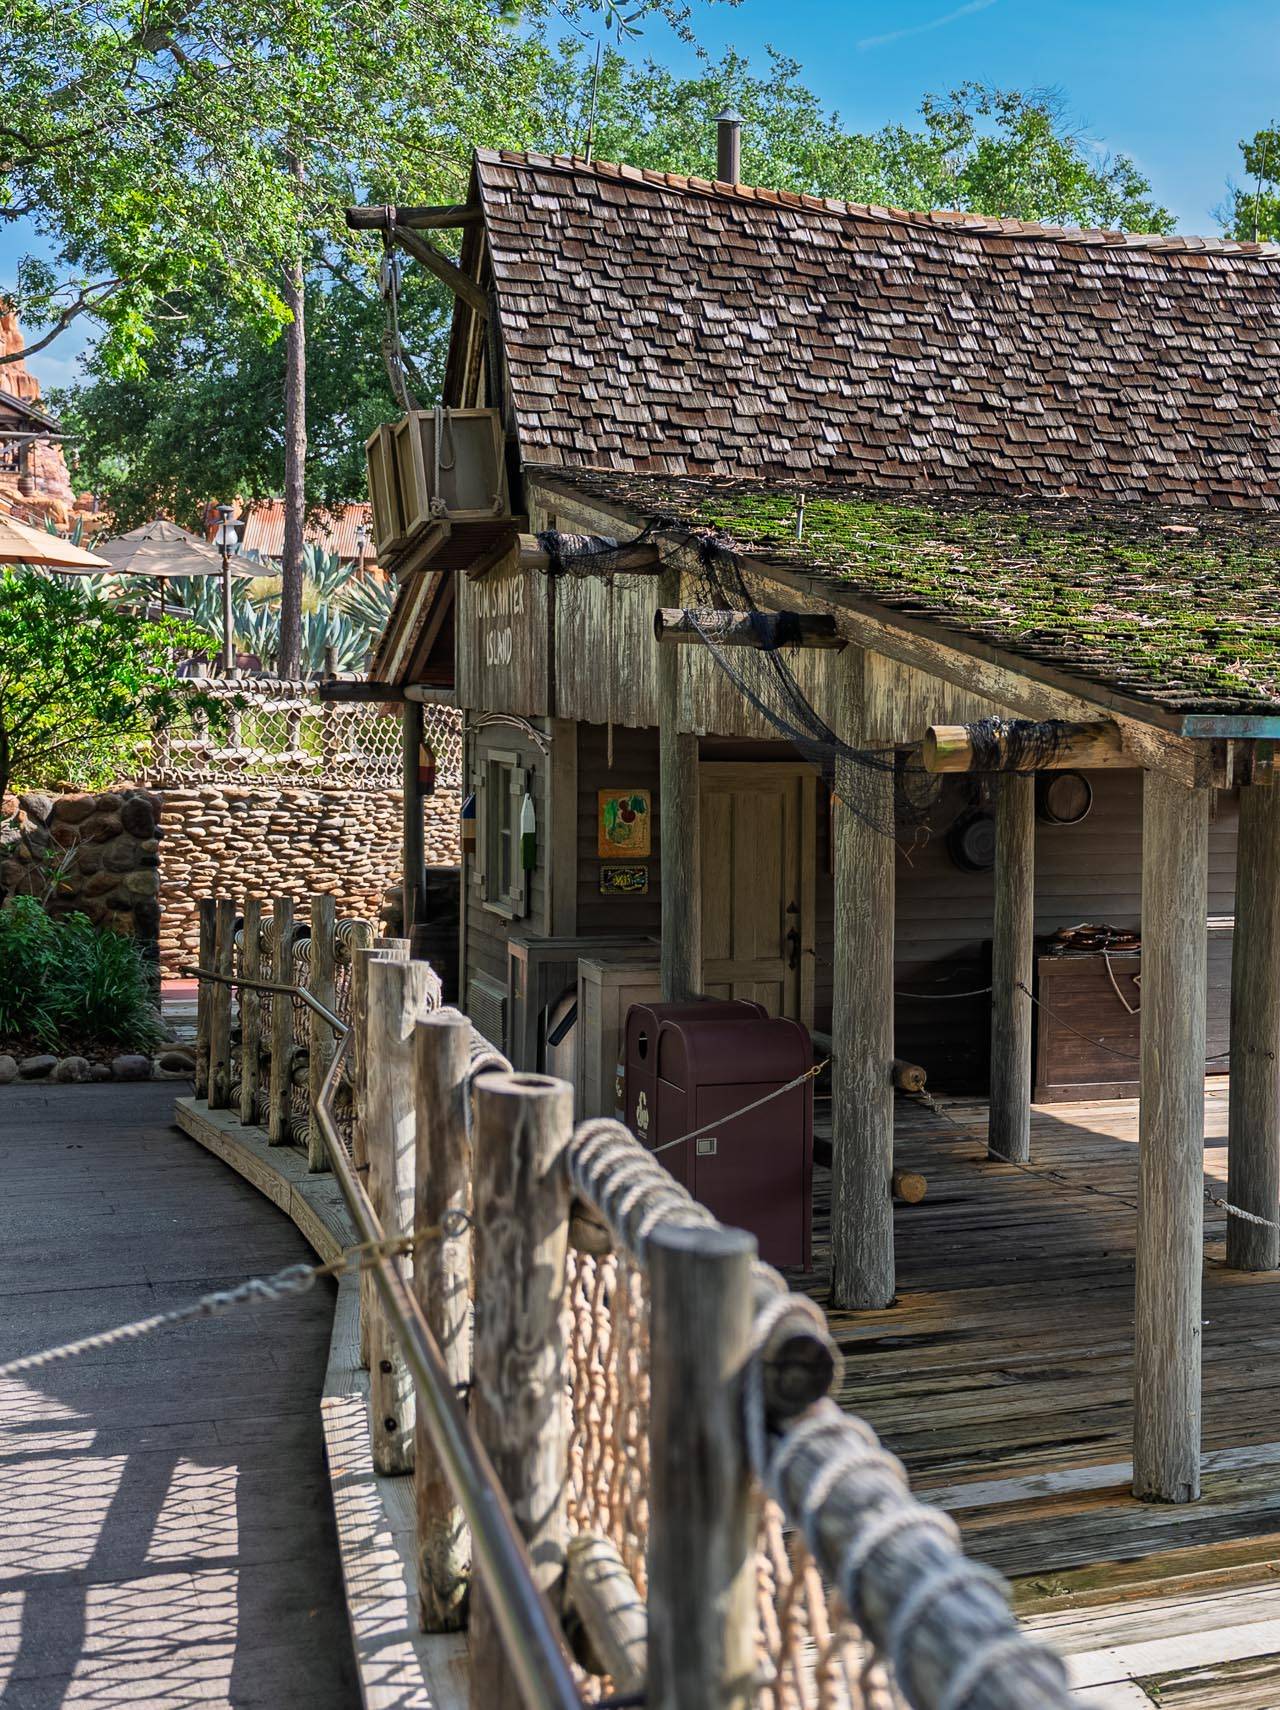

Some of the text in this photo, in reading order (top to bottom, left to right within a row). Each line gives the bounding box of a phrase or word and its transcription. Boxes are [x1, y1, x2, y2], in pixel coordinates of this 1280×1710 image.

[475, 573, 524, 618] TOM SAWYER
[486, 626, 512, 667] ISLAND
